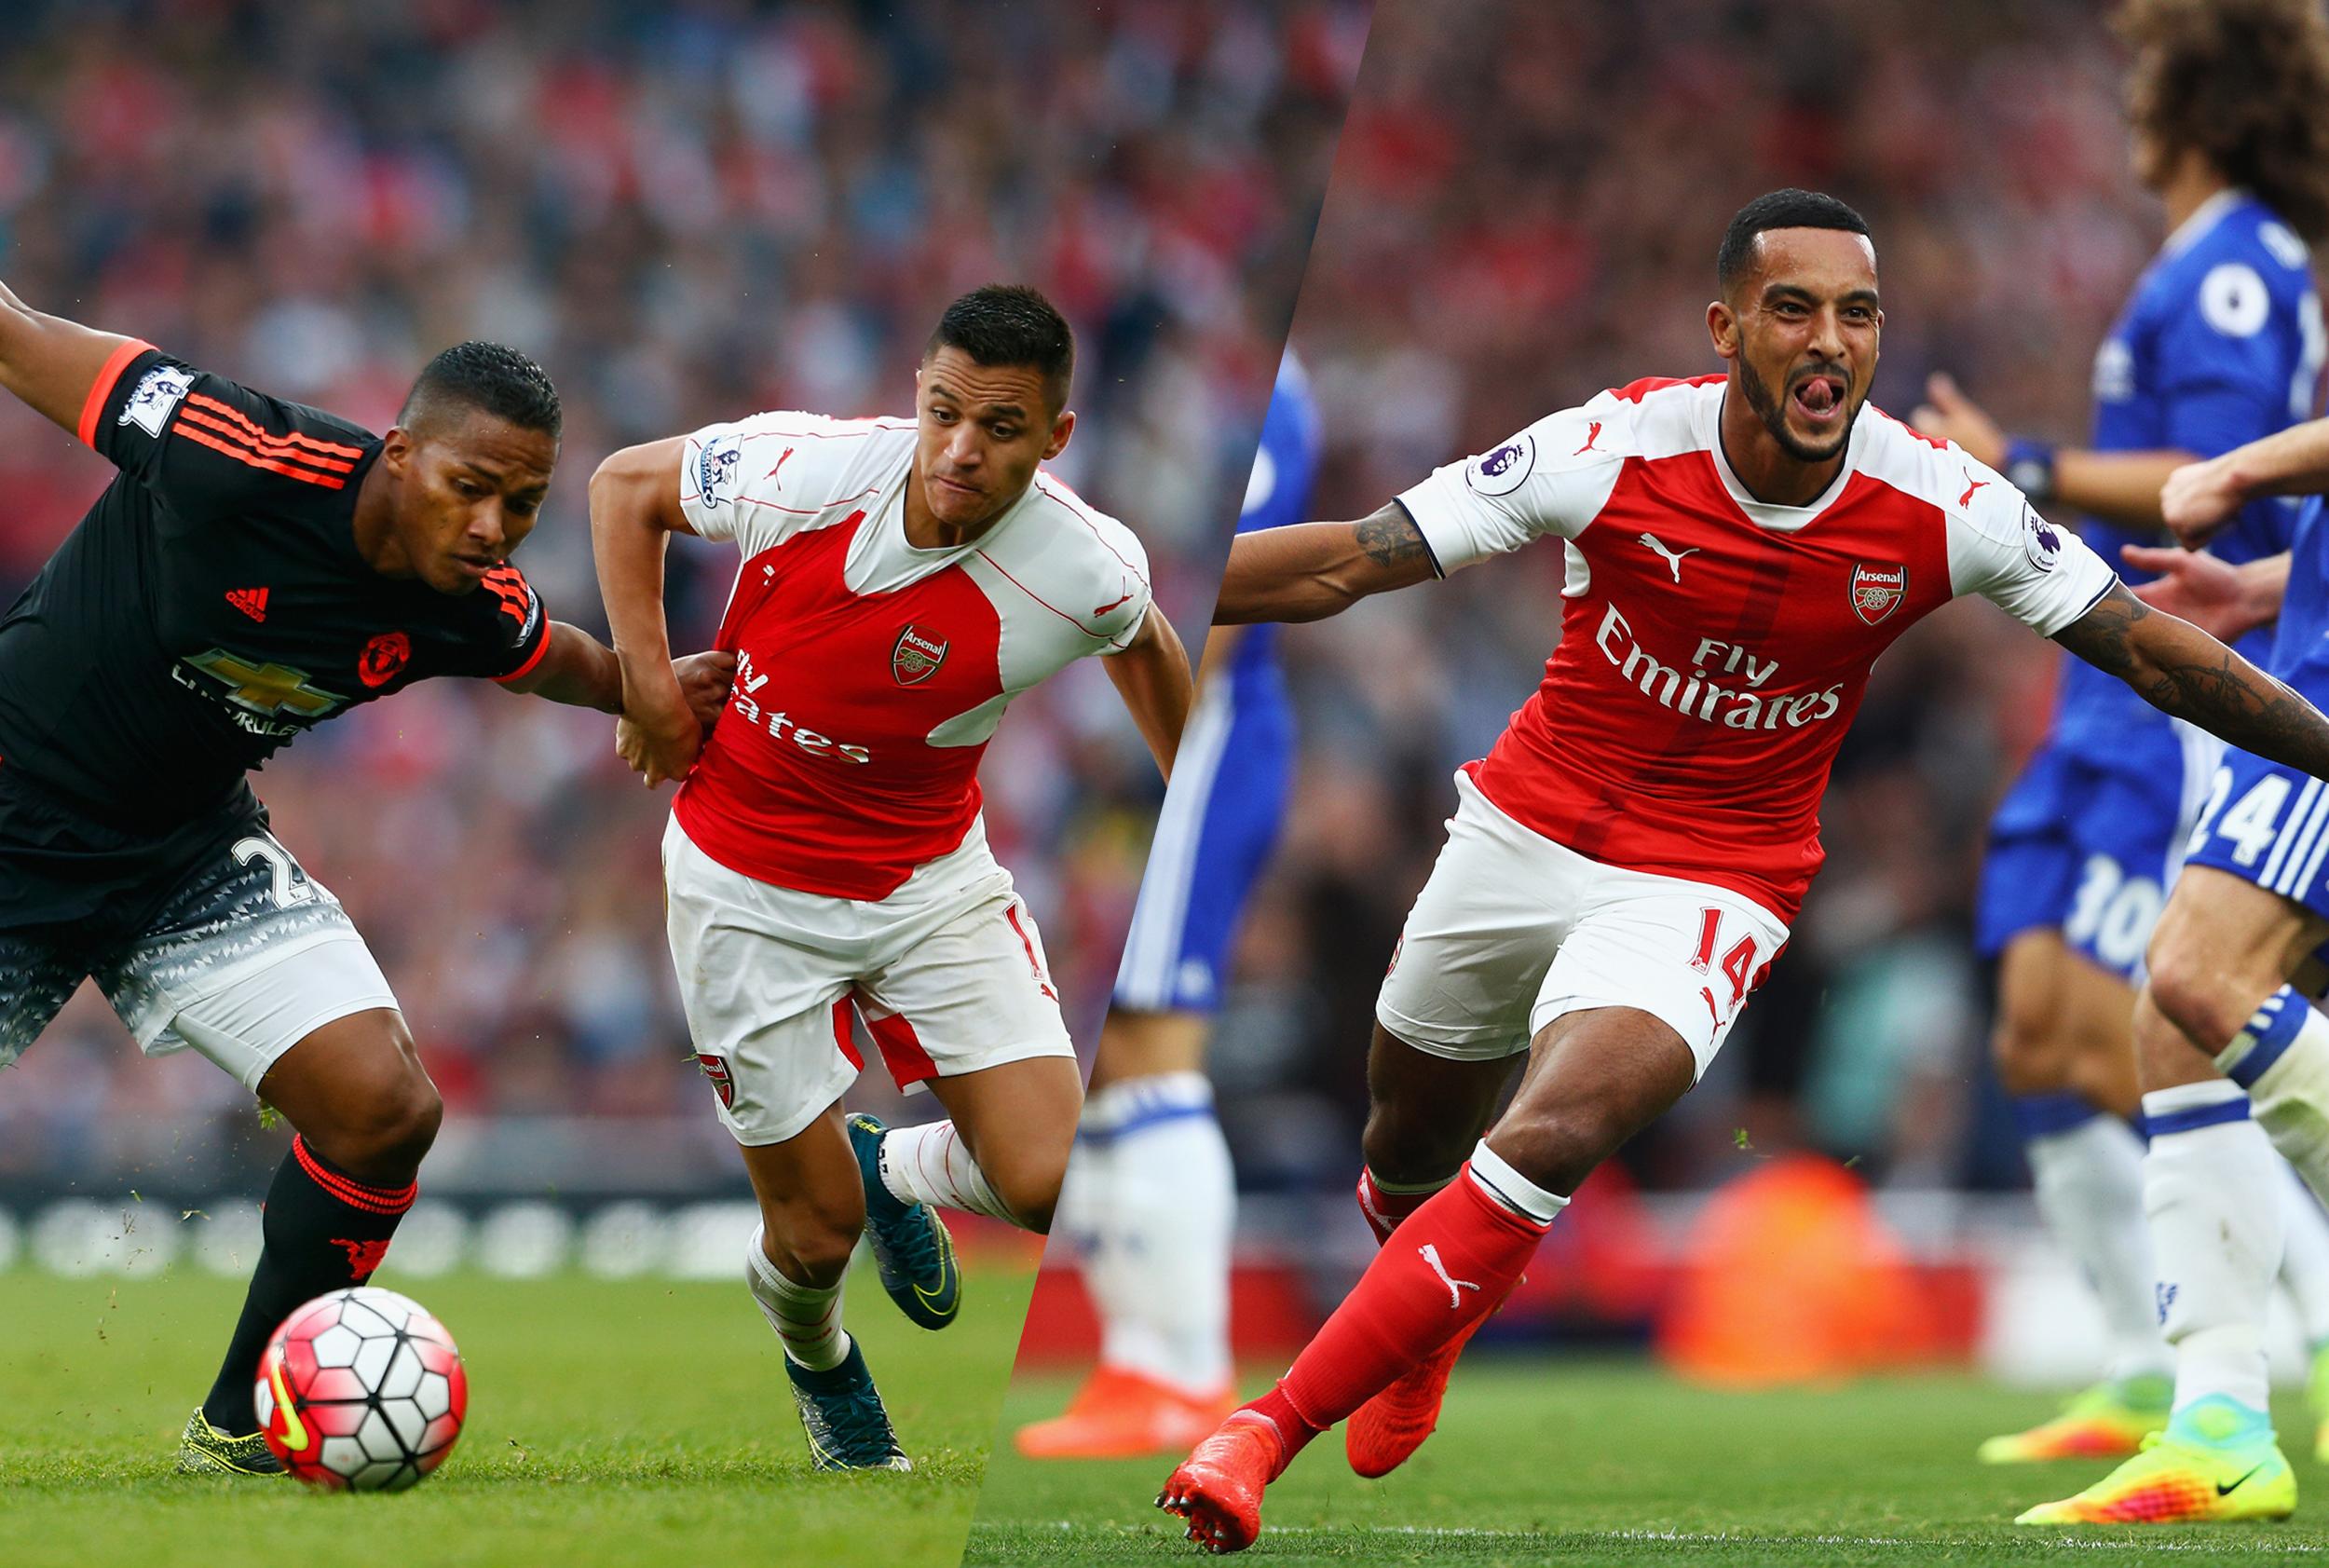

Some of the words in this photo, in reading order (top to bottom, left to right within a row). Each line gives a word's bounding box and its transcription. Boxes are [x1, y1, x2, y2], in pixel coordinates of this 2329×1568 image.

[1857, 570, 1901, 583] Arsenal
[225, 592, 266, 623] adidas
[905, 632, 943, 656] Arsenal
[1692, 636, 1779, 688] Fly
[1596, 600, 1844, 730] Emirates
[1685, 906, 1759, 1017] 14
